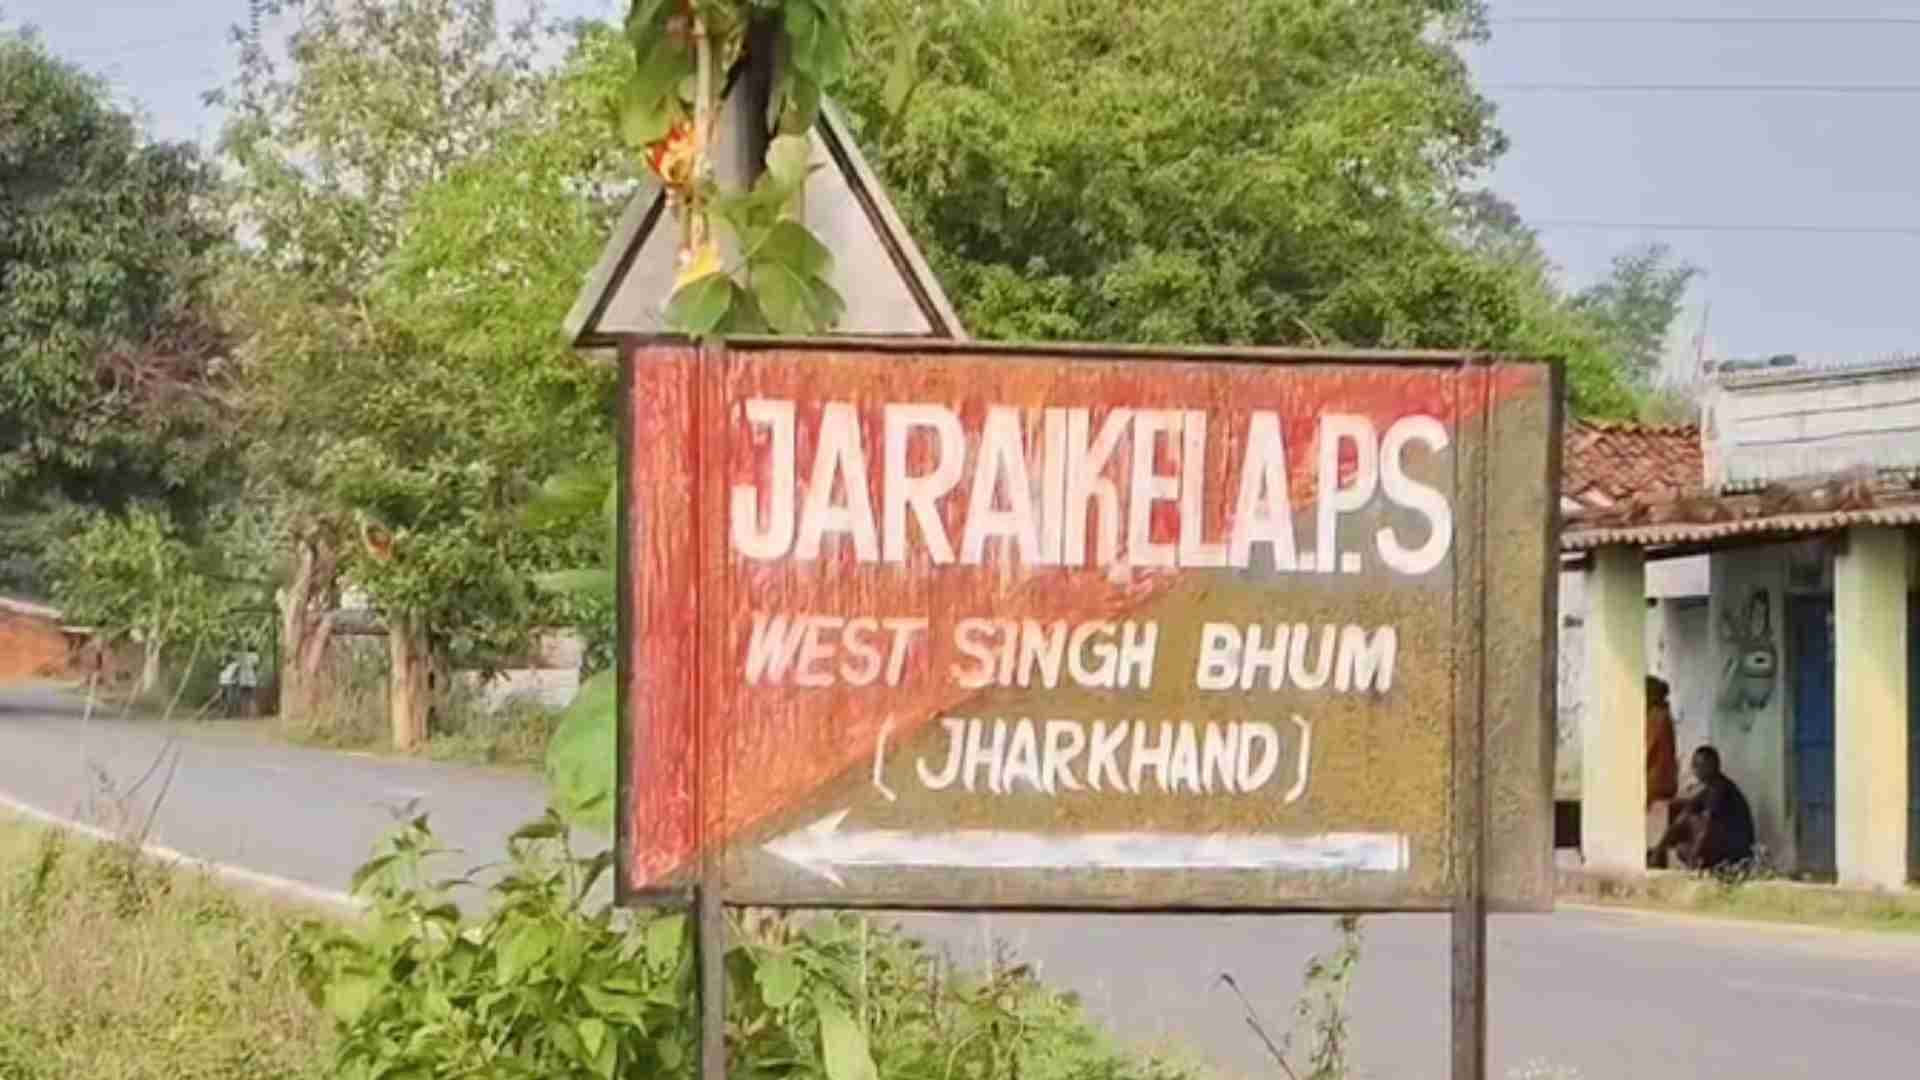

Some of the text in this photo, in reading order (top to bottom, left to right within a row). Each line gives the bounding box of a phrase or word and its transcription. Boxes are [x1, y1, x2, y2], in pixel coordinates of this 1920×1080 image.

[745, 614, 1396, 693] WEST SINGH BHUM
